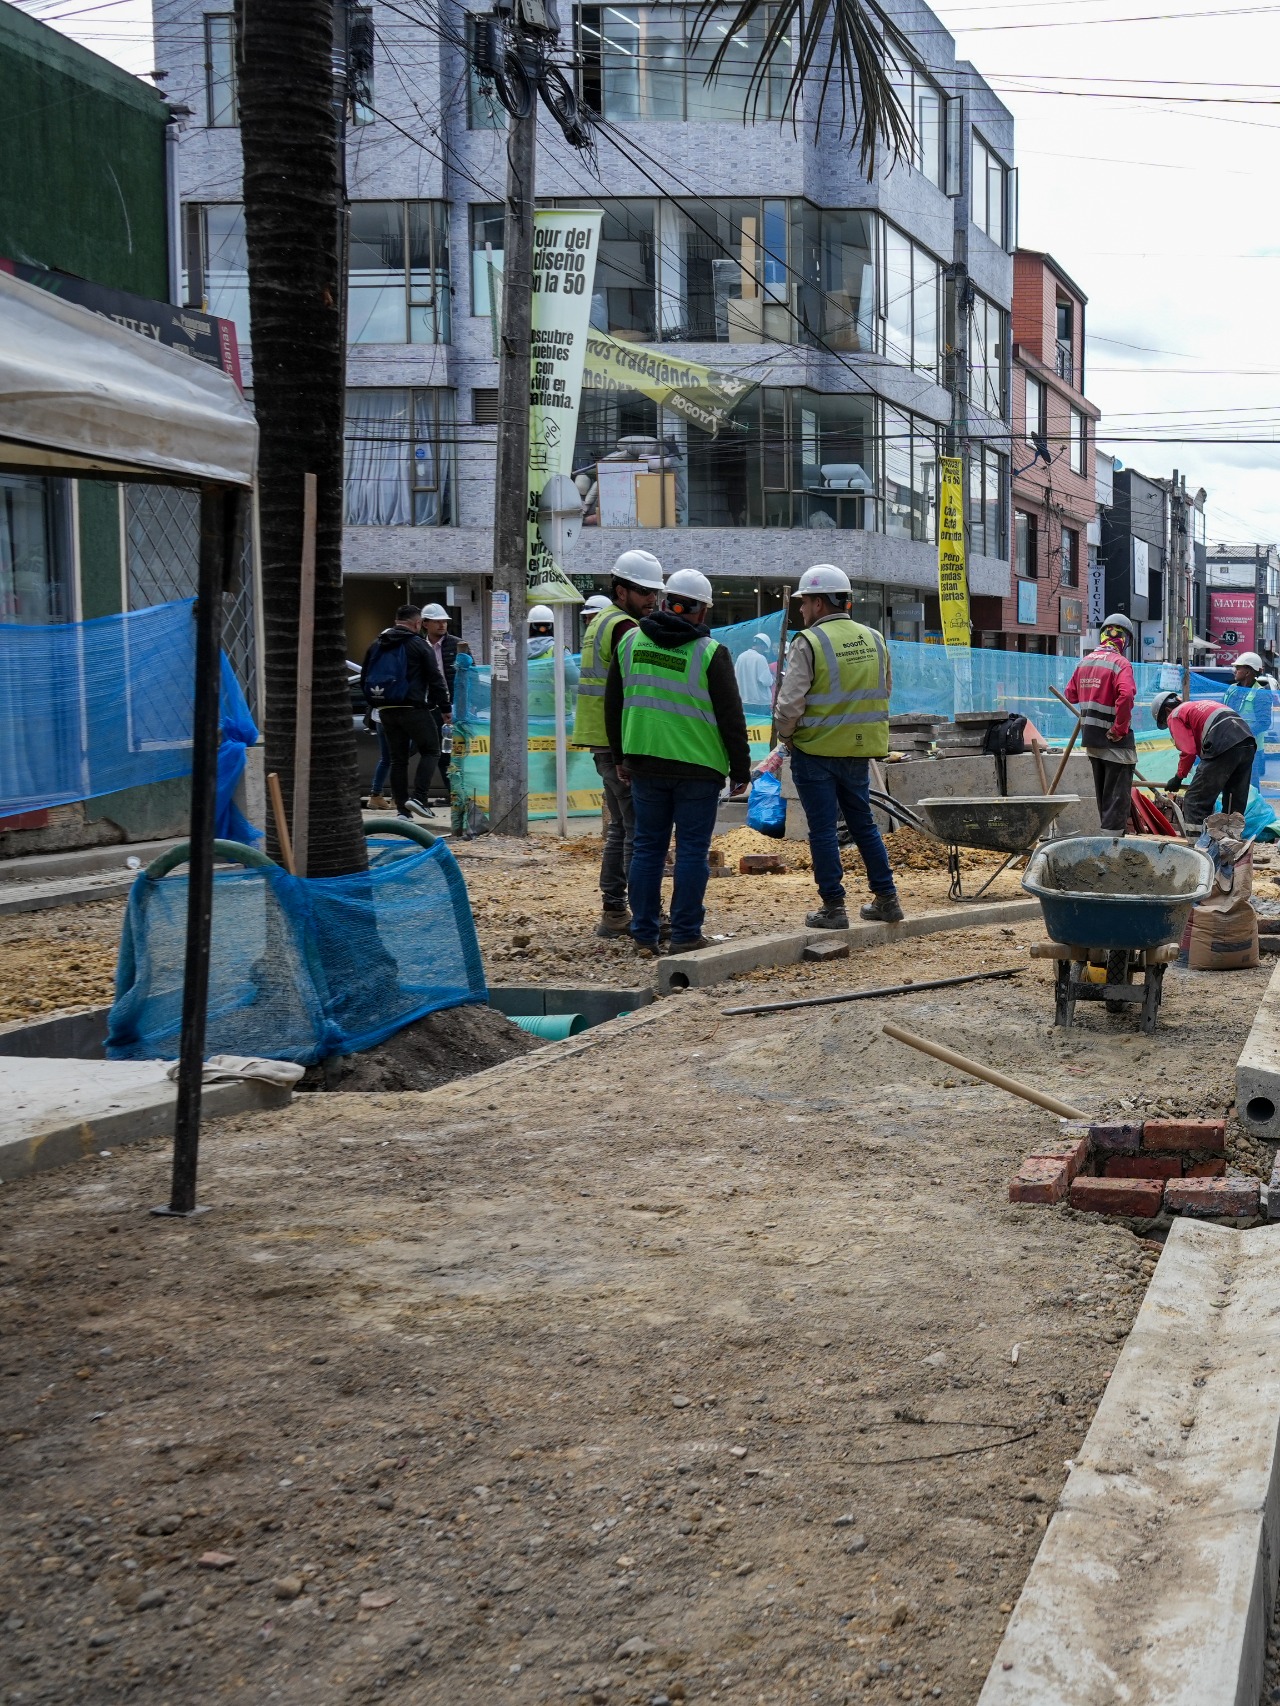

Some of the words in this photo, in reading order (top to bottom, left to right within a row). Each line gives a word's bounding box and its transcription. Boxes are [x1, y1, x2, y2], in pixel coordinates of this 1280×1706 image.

[565, 228, 591, 250] del
[534, 248, 586, 273] diseño
[545, 275, 558, 294] la
[563, 274, 586, 295] 50
[221, 326, 234, 377] rsianas
[533, 344, 570, 361] uebles
[536, 362, 554, 375] con
[531, 377, 549, 391] stilo
[554, 380, 566, 393] en
[941, 572, 962, 581] endas
[941, 592, 965, 602] iertas
[1093, 572, 1101, 622] OFICINA
[1214, 599, 1255, 608] MAYTEX
